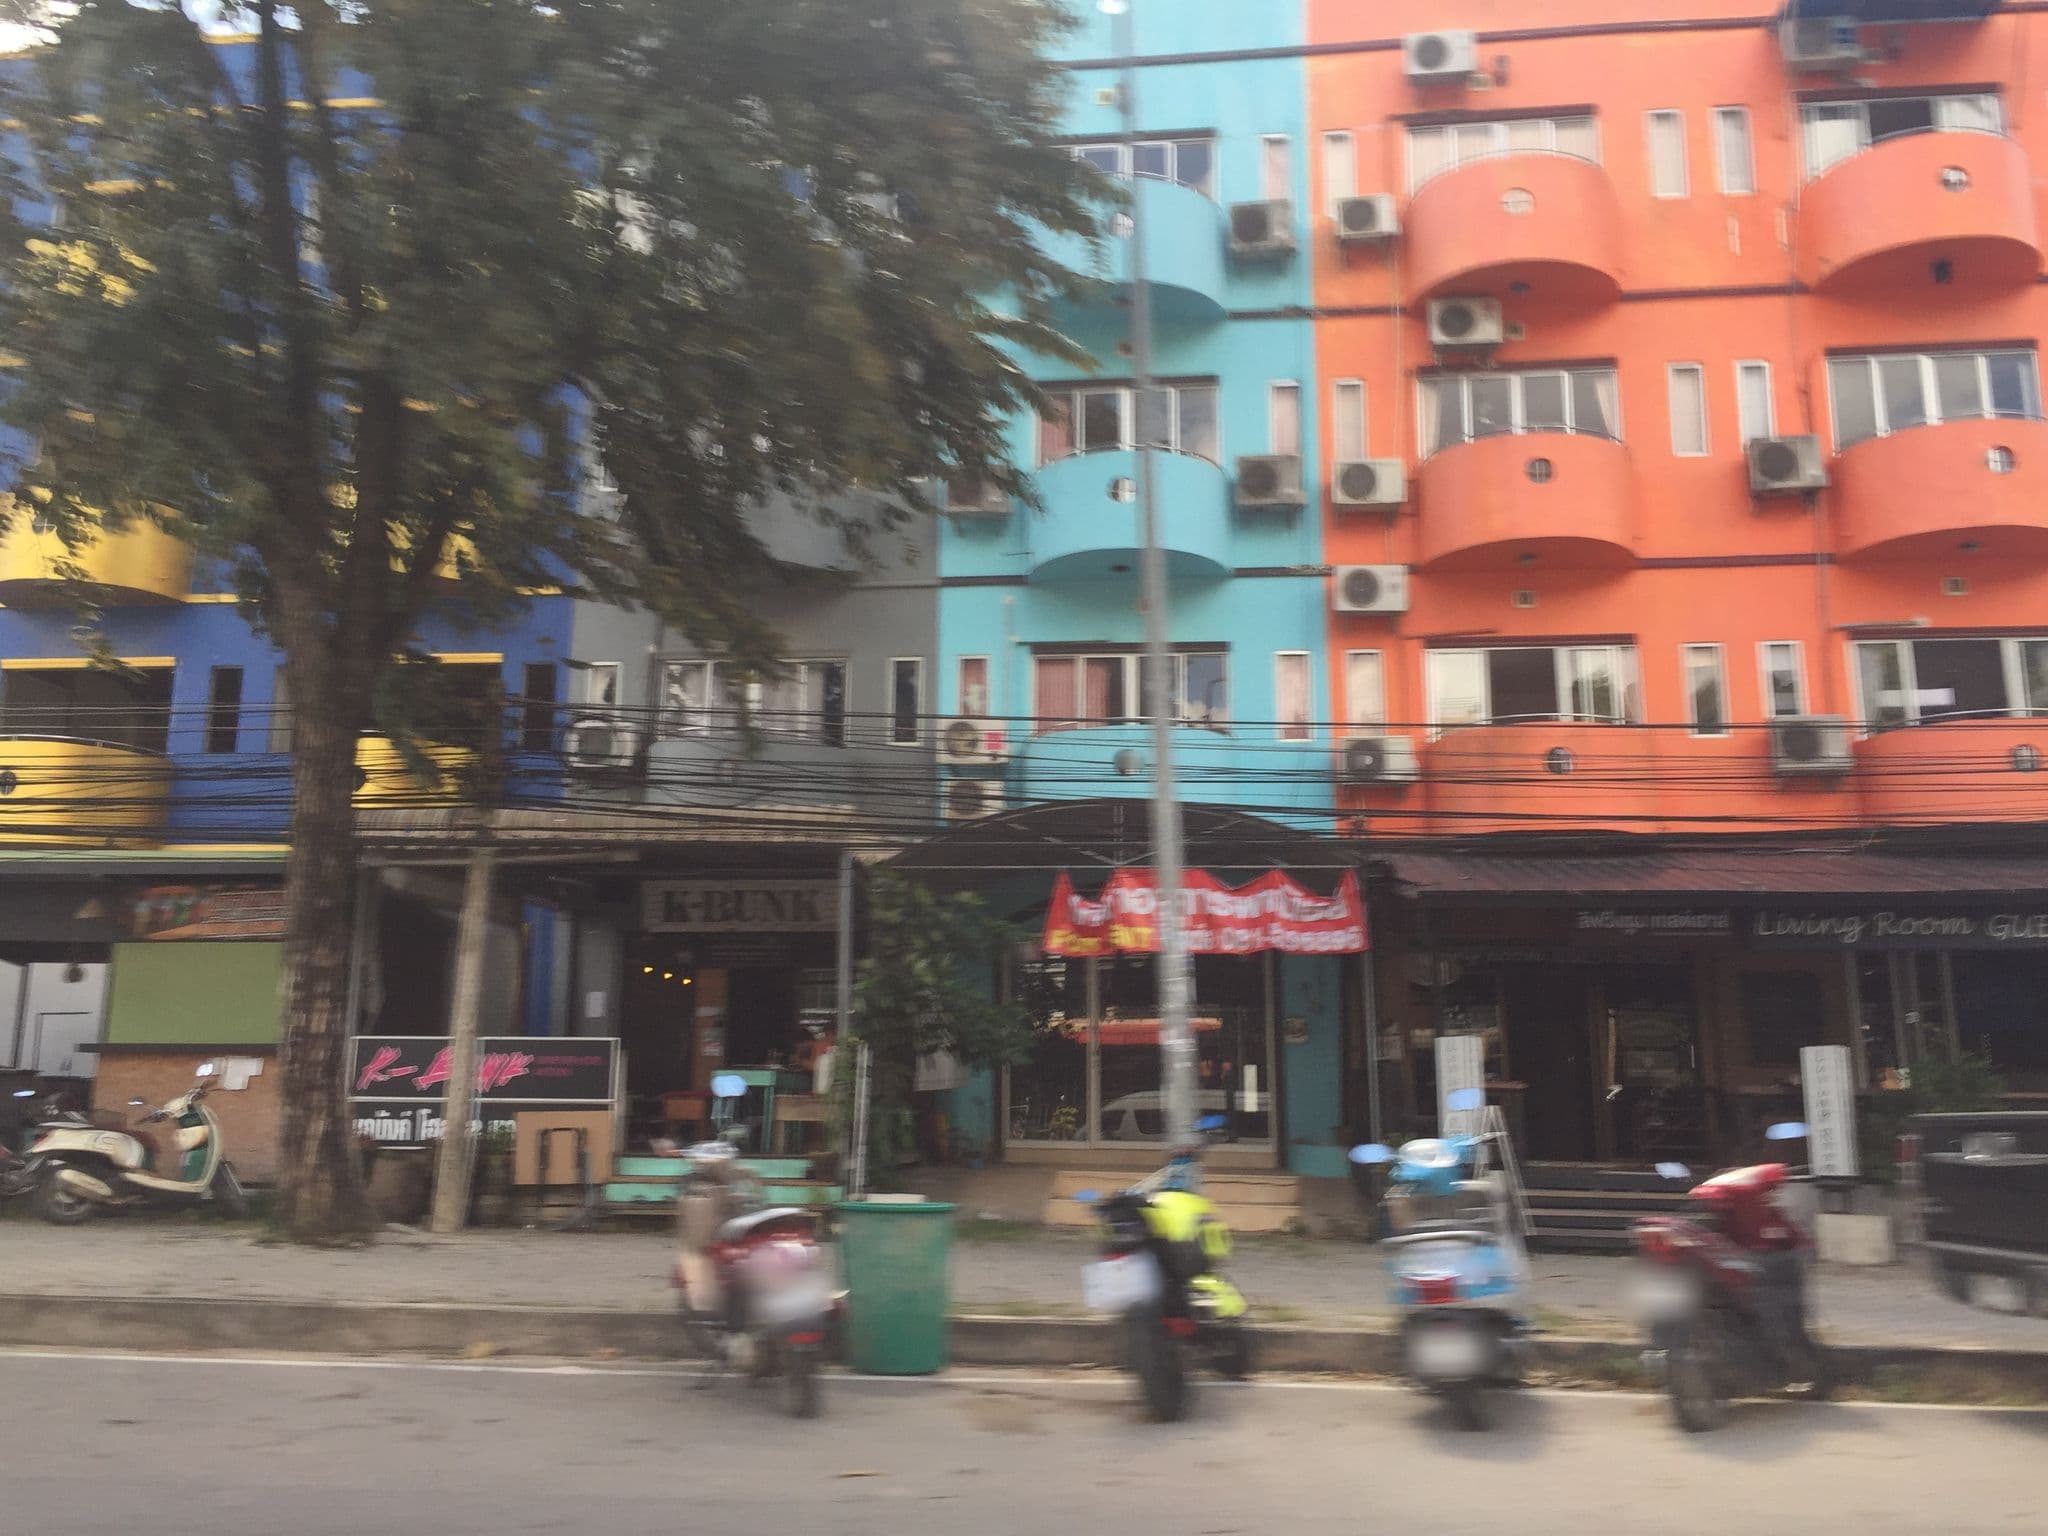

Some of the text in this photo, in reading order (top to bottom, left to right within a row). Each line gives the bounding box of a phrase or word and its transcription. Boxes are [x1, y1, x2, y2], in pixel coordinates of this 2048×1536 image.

[663, 889, 825, 923] K-BUNK
[1756, 911, 1865, 943] Living
[1872, 911, 1973, 937] Room
